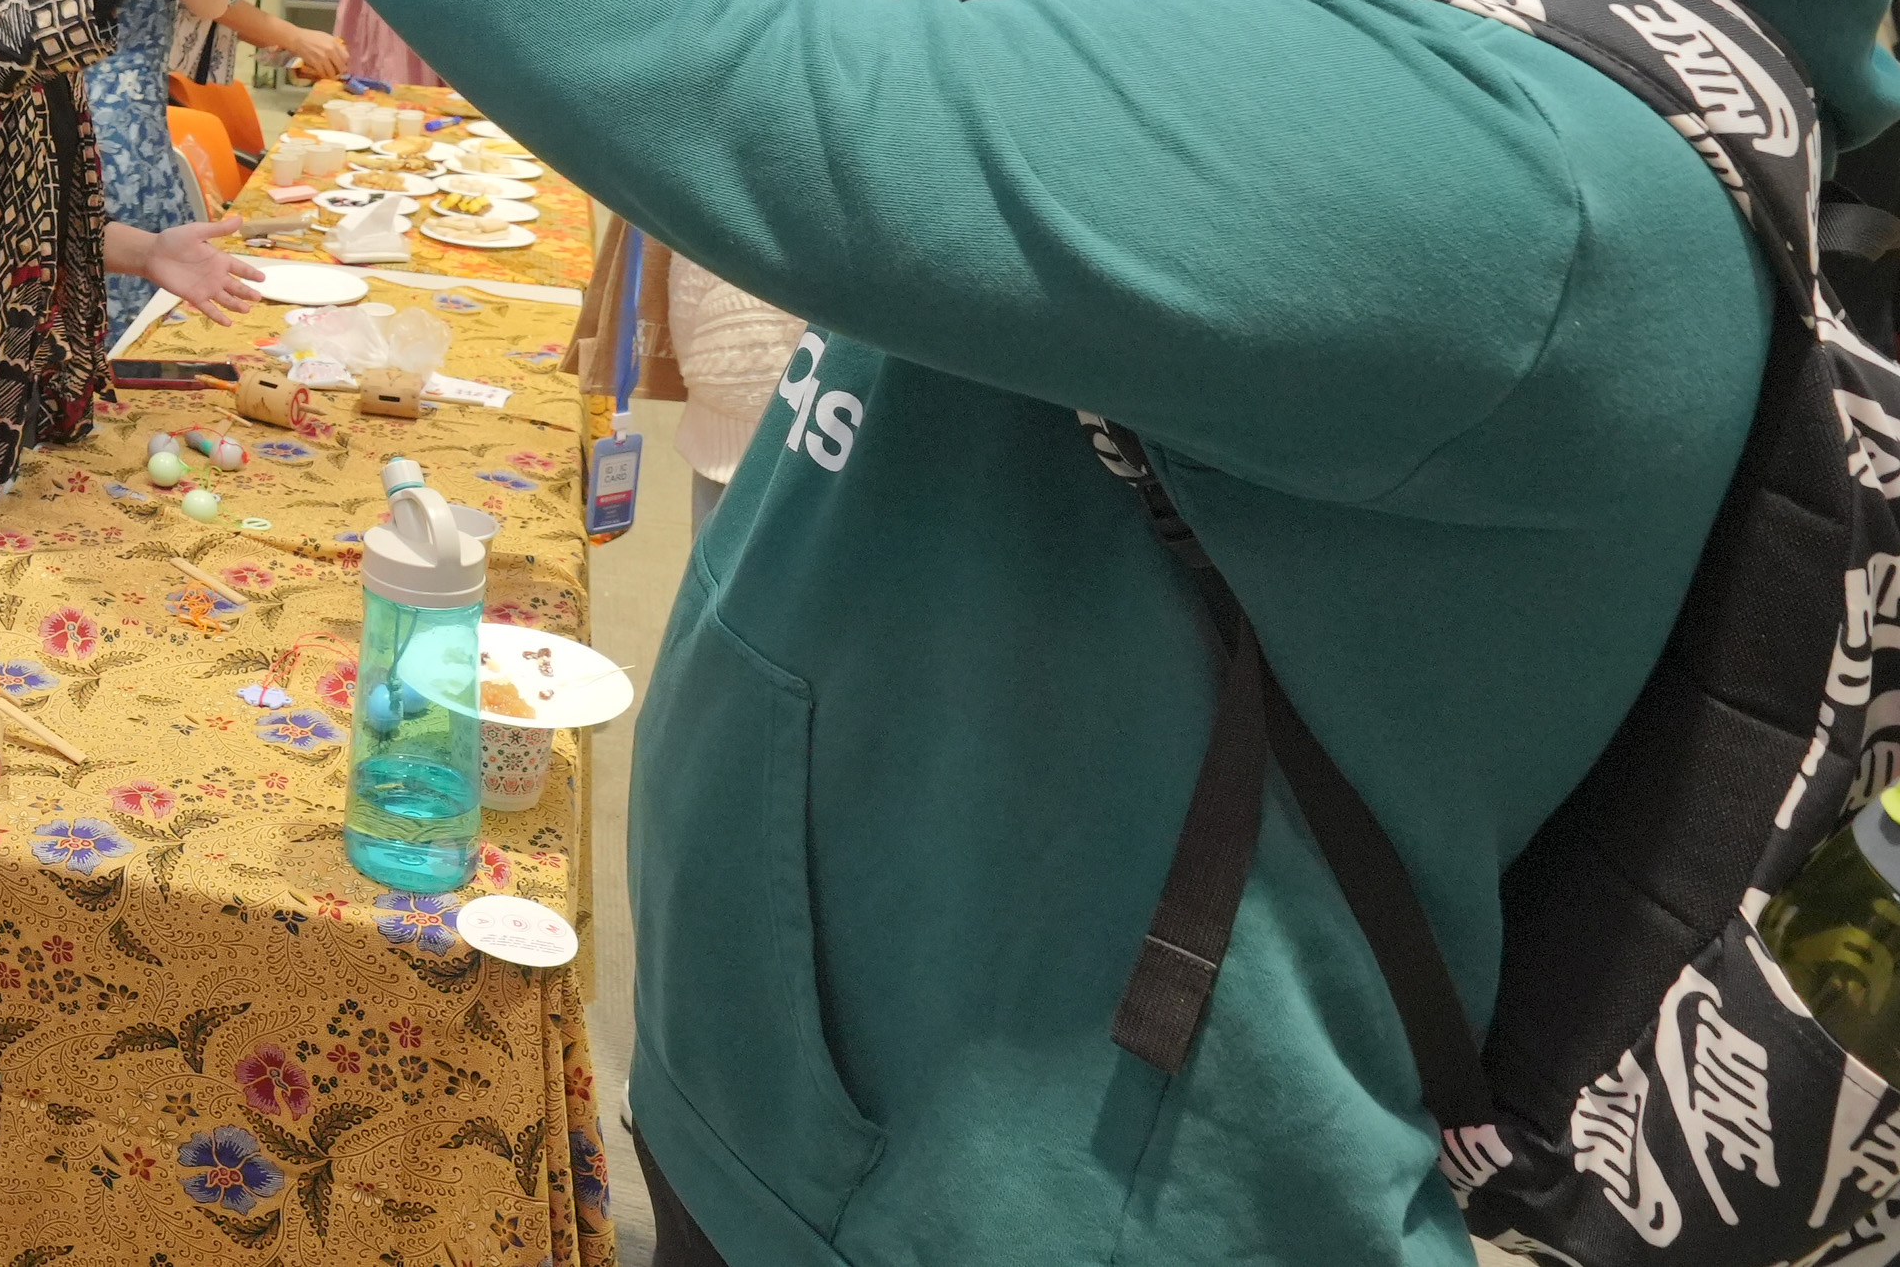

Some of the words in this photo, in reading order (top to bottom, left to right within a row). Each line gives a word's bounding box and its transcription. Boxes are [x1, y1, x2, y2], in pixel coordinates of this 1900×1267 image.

[1610, 2, 1768, 135] NIKE
[603, 472, 628, 484] CARD
[1695, 998, 1782, 1189] NIKE
